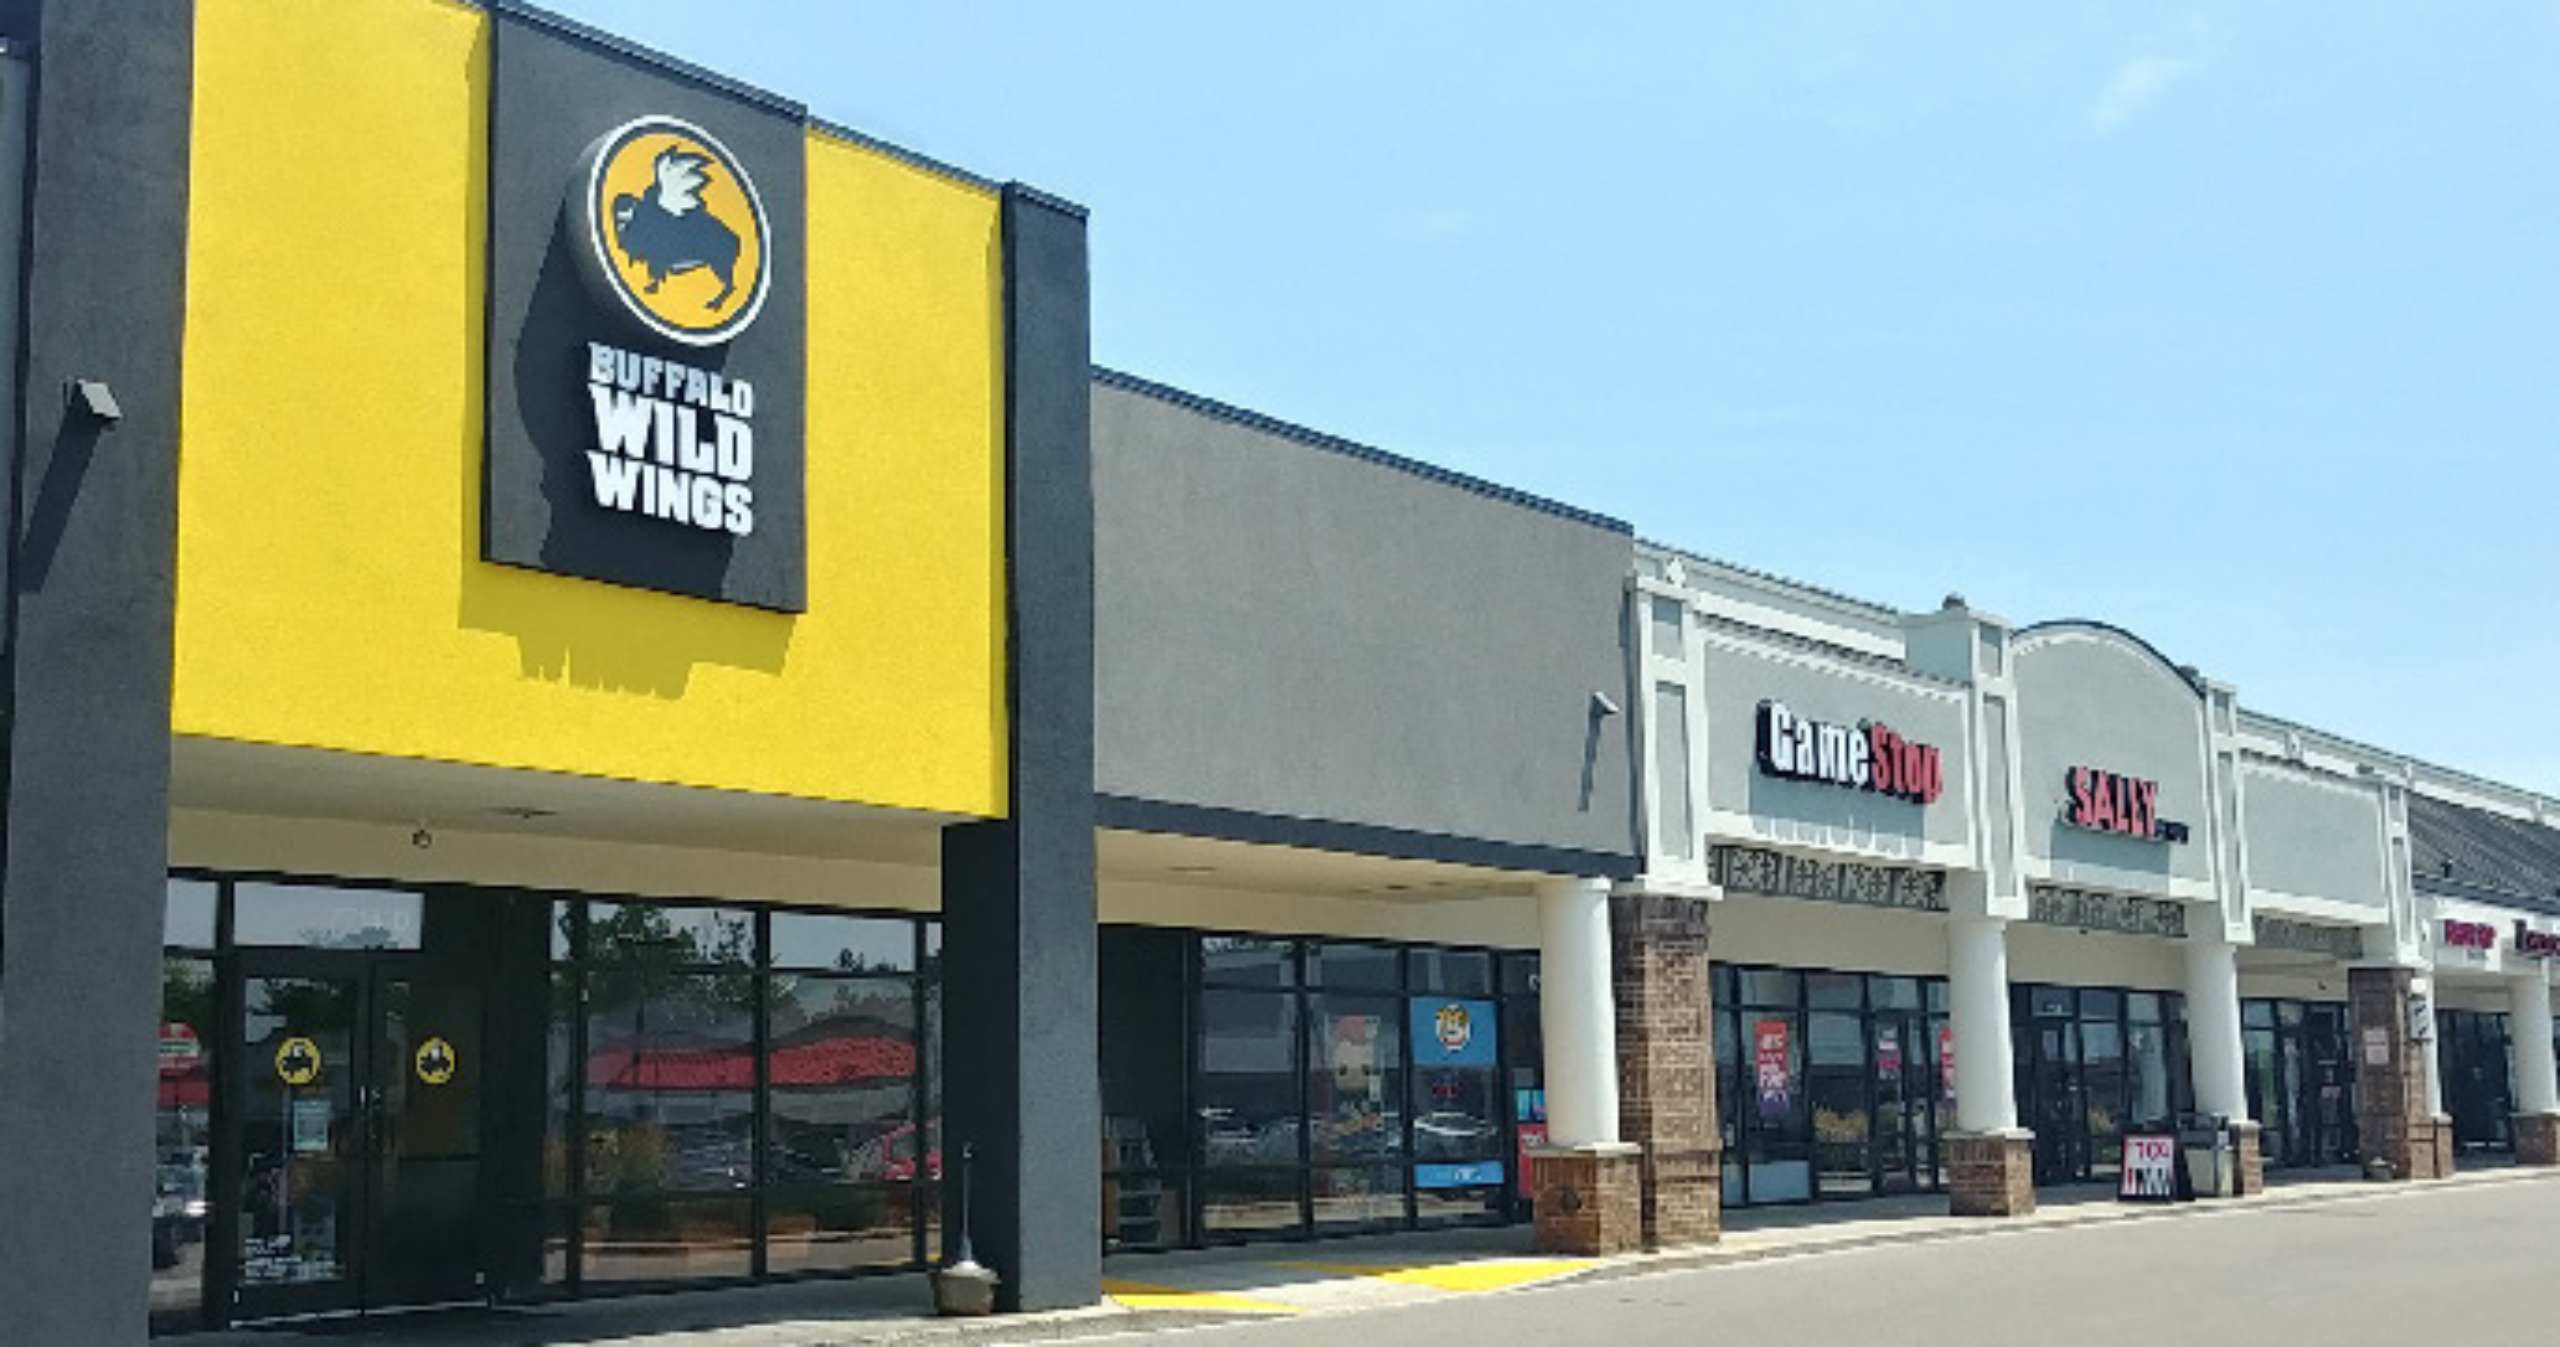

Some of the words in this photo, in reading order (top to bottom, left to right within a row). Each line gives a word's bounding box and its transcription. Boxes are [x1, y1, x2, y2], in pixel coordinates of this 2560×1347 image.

[588, 341, 753, 418] BUFFALO
[588, 382, 753, 481] WILD
[585, 450, 753, 536] WINGS
[1764, 700, 1943, 804] GameStop
[2069, 766, 2158, 837] SALLY
